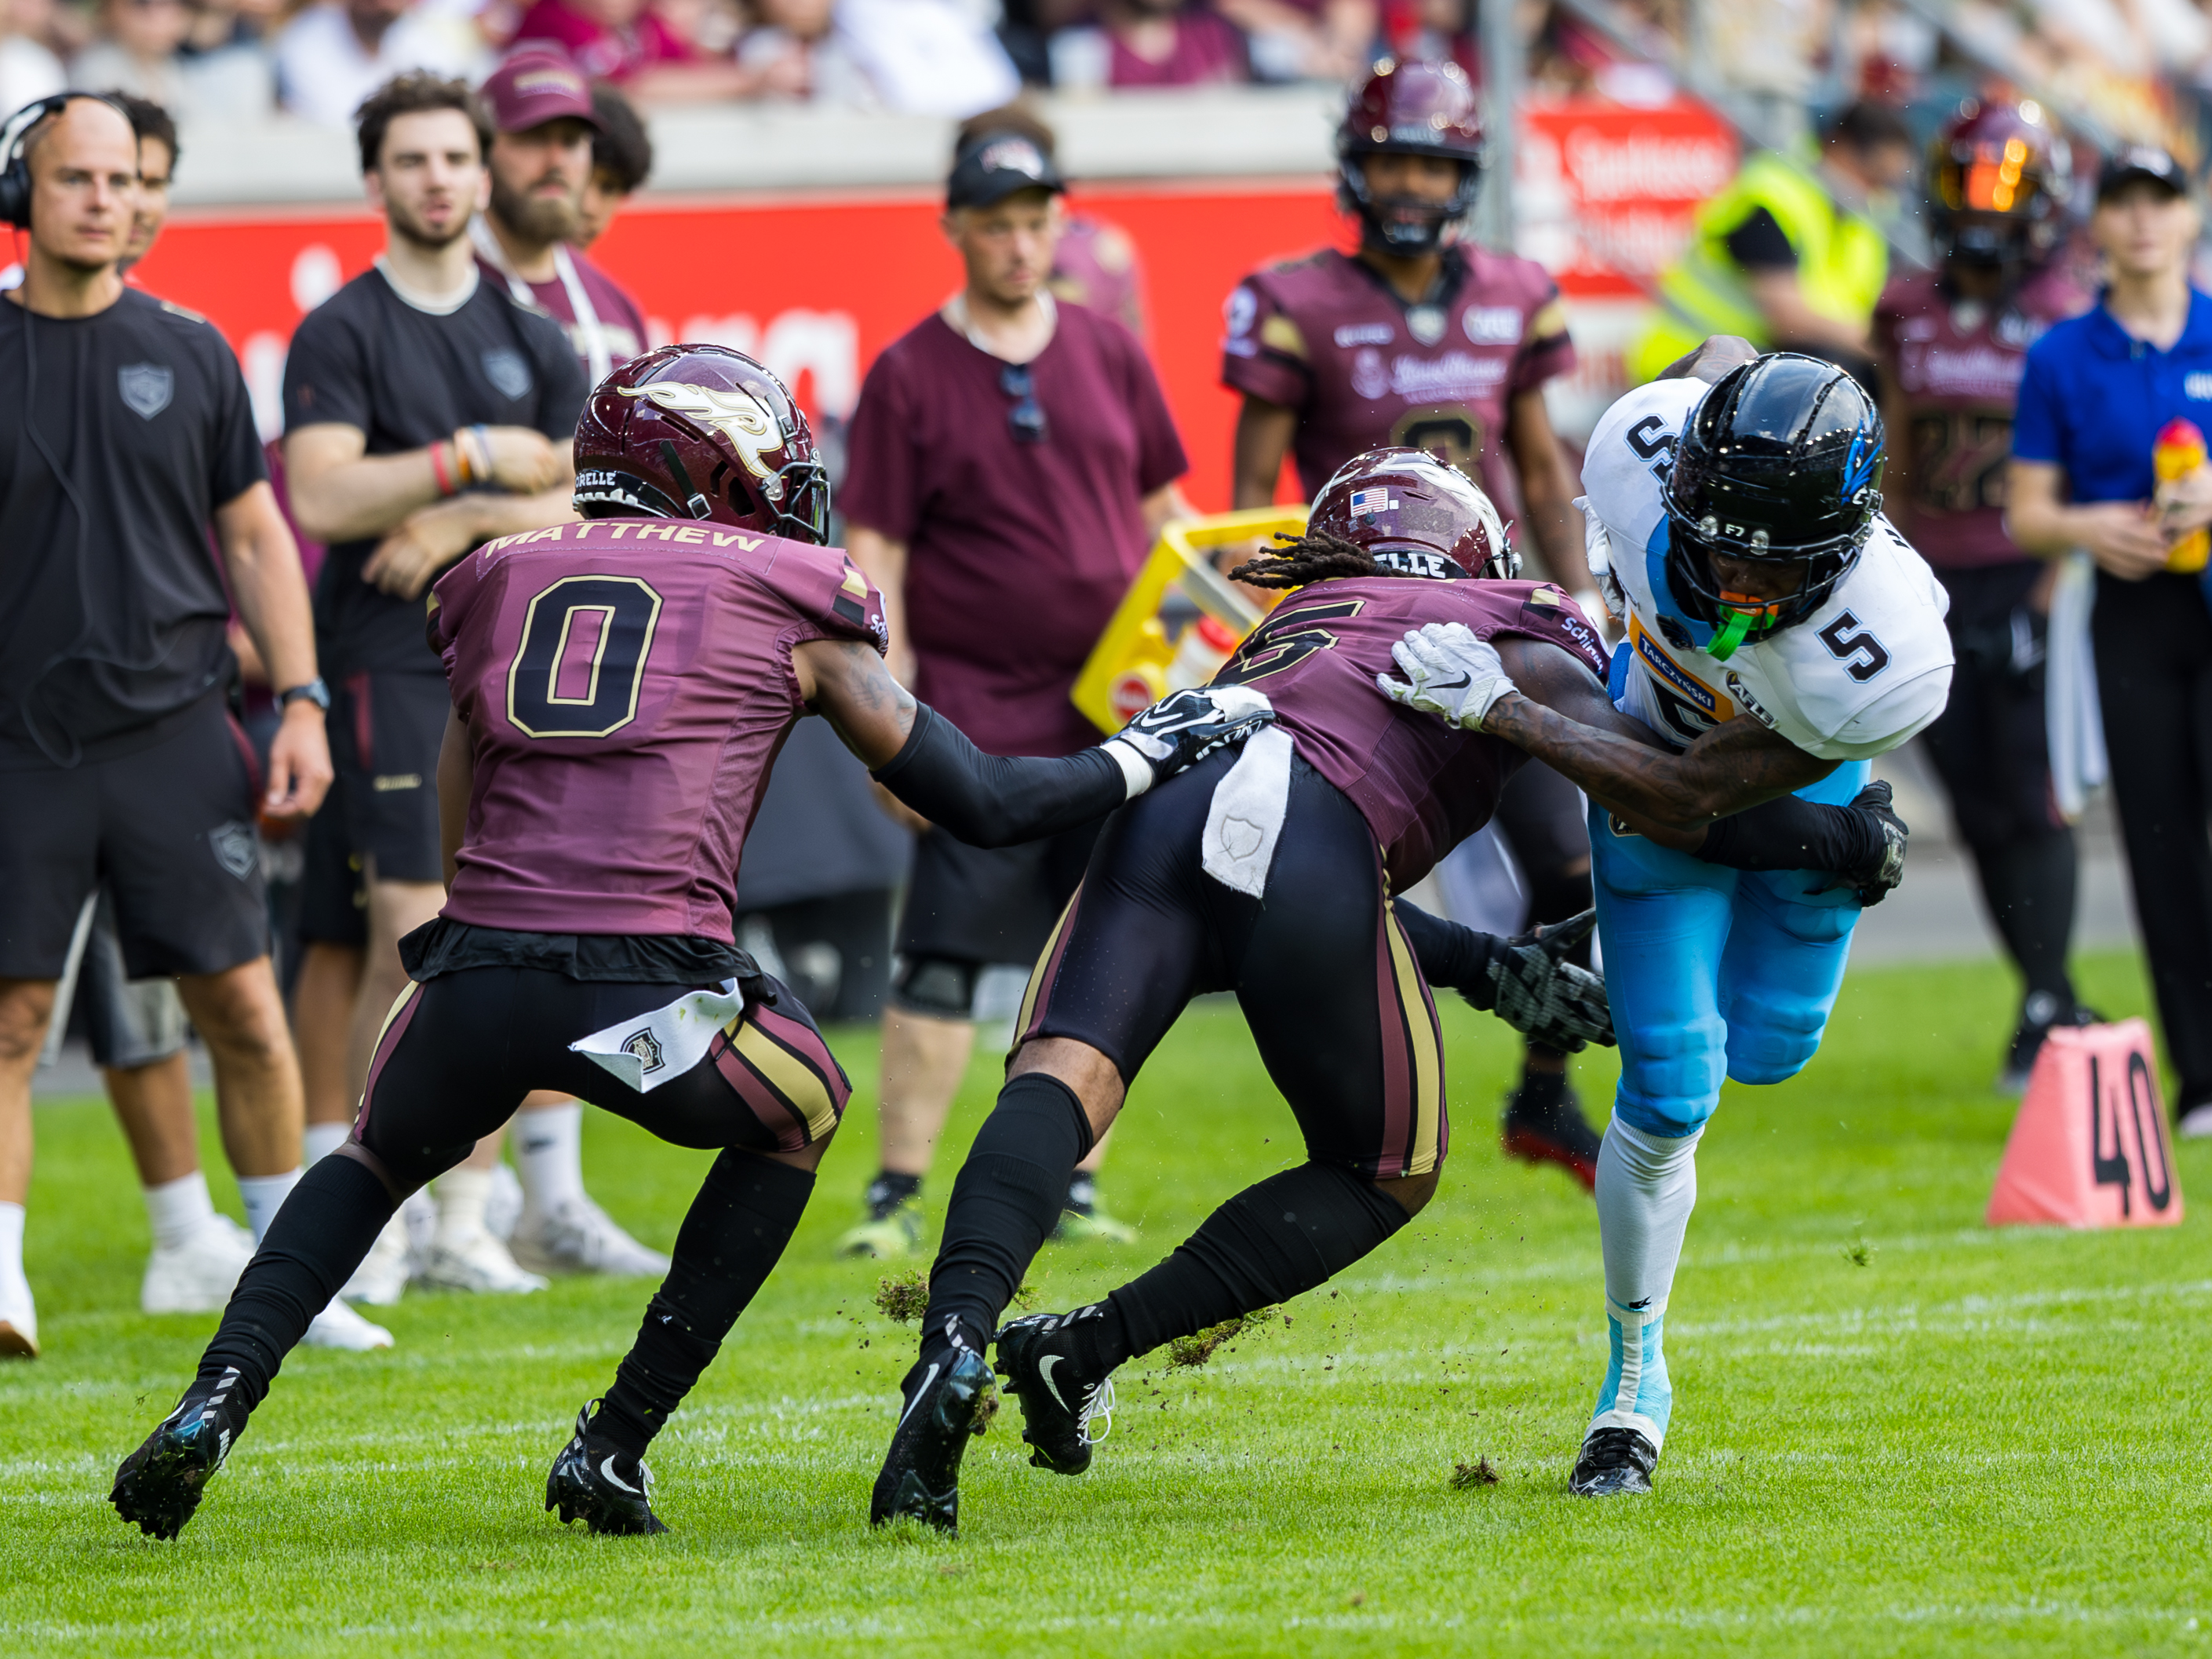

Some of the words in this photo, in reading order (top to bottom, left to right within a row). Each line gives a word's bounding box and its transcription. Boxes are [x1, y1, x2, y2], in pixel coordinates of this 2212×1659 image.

[485, 522, 765, 560] MATTHEW
[507, 574, 663, 739] 0
[1642, 637, 1711, 707] TARCZYŃSKI
[1815, 607, 1892, 684] 5
[1729, 684, 1775, 726] AFLE
[2090, 1051, 2170, 1222] 40
